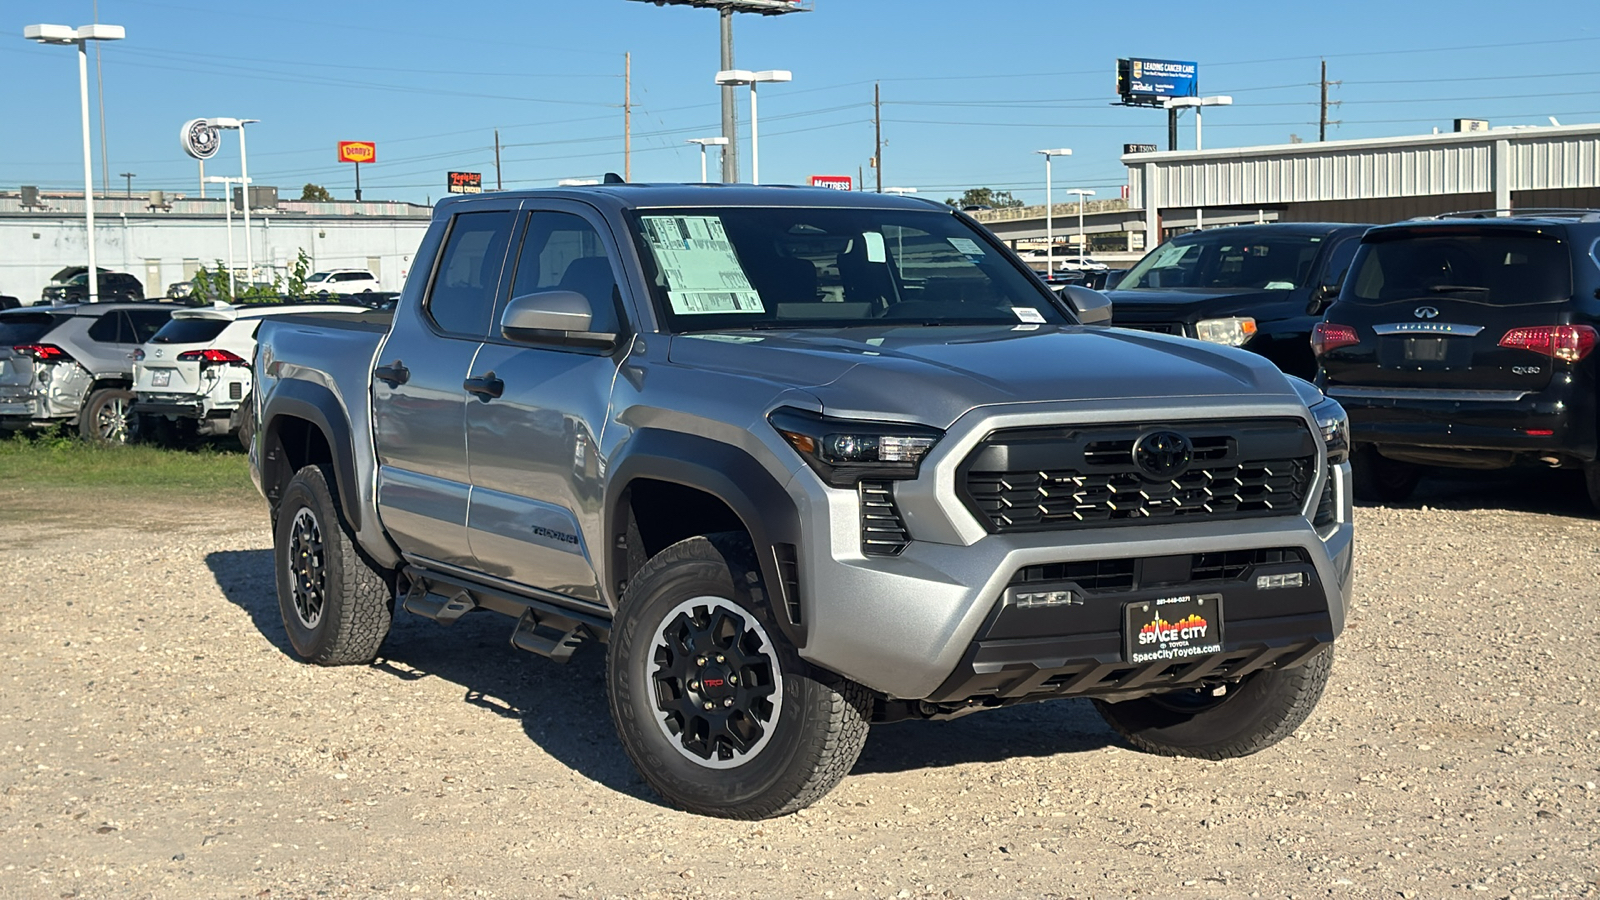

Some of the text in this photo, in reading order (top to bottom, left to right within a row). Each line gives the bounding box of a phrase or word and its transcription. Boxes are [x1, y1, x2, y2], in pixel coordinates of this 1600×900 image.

[1144, 62, 1195, 74] LEADING CANCER CARE
[346, 147, 371, 157] Denny's
[814, 180, 849, 190] MATTRESS
[1512, 366, 1541, 375] QX80
[1138, 626, 1207, 644] SPACE CITY
[1133, 645, 1220, 662] SpaceCityToyota.com
[704, 679, 724, 687] TRD
